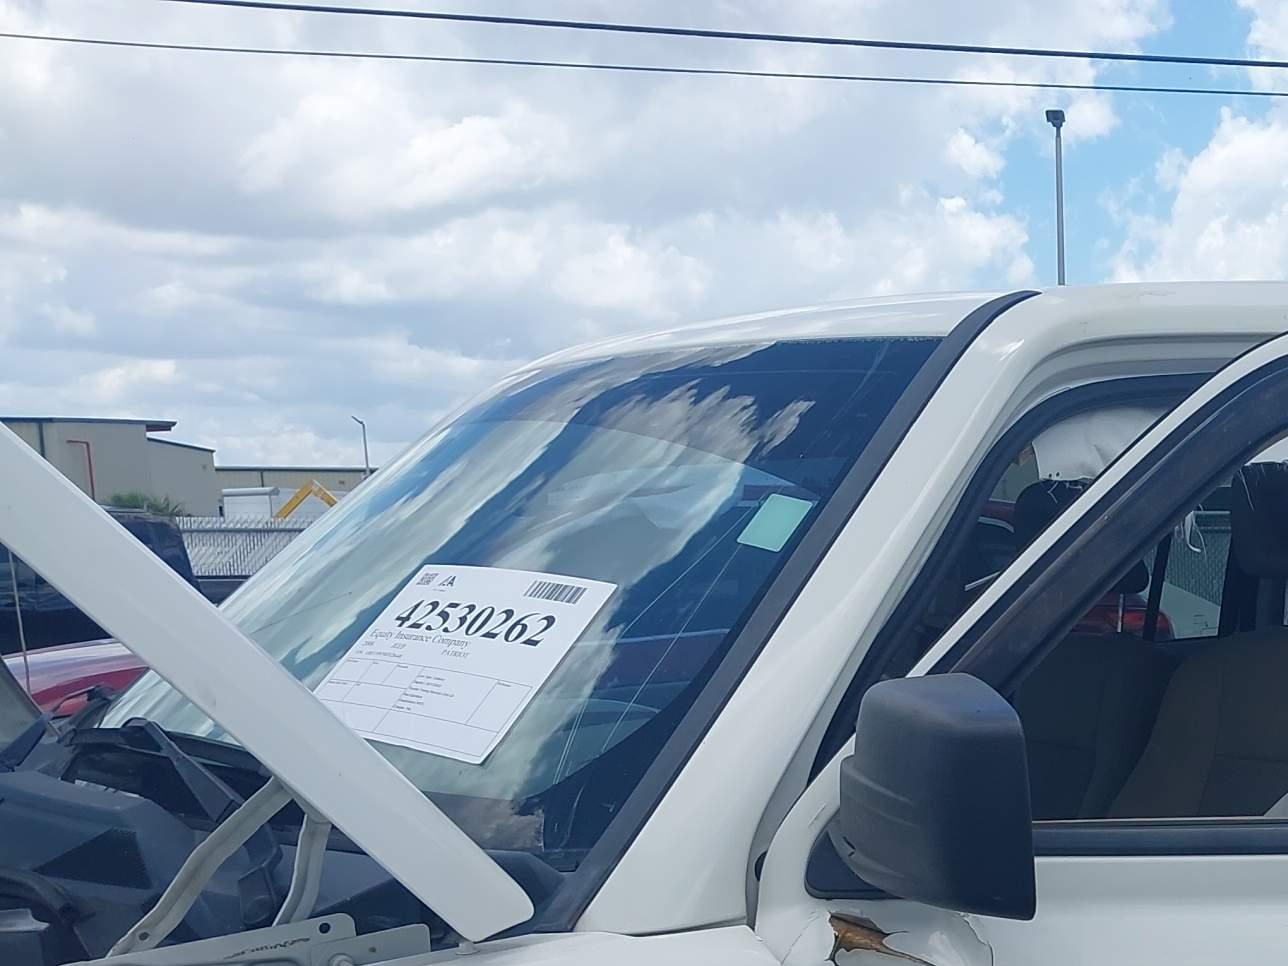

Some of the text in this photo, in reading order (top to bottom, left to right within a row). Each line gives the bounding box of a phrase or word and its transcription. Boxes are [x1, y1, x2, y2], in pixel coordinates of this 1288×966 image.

[394, 630, 432, 643] Insurance
[432, 634, 470, 650] Company
[395, 599, 557, 647] 42530262
